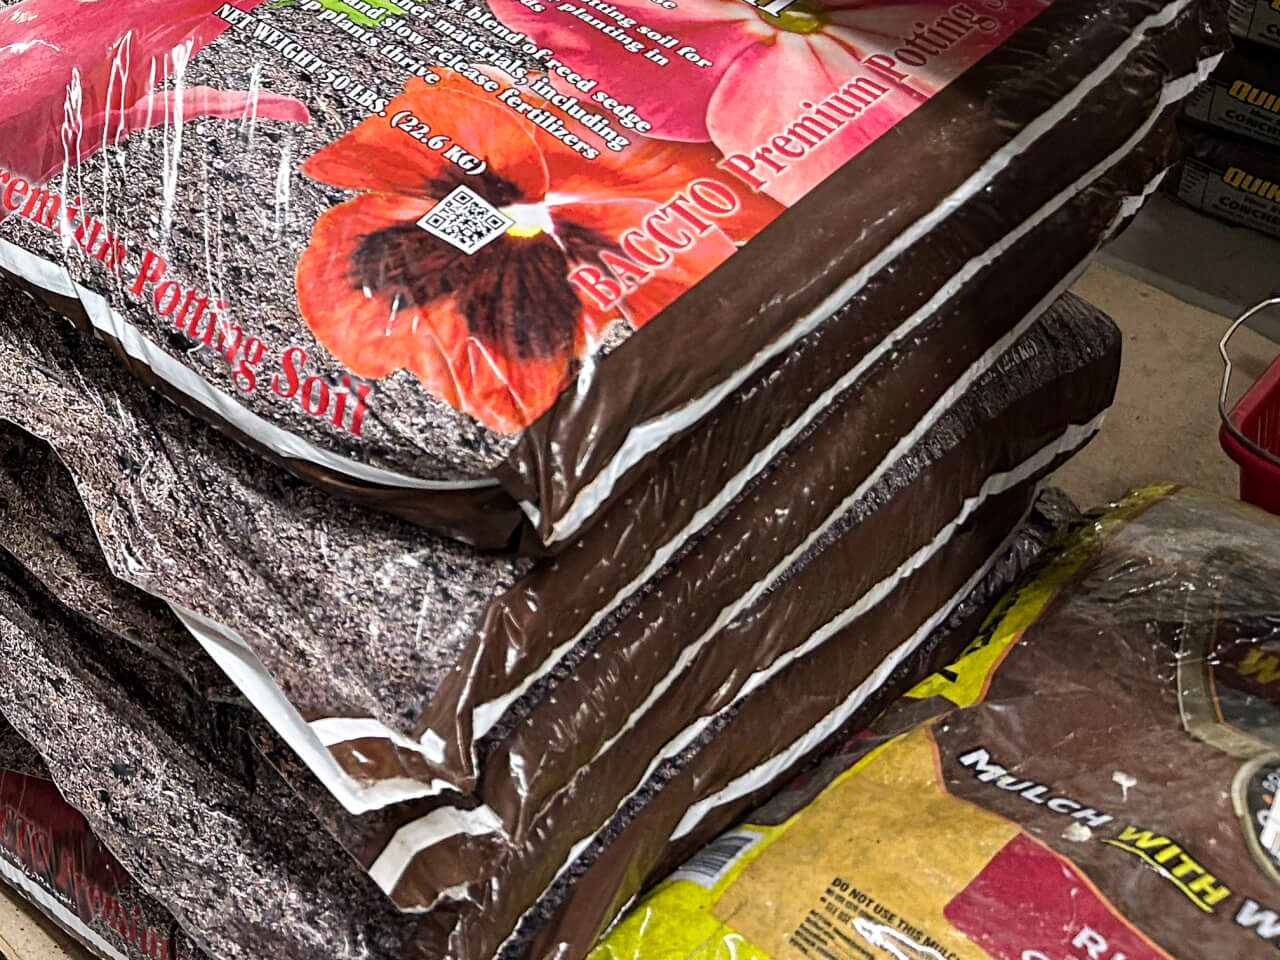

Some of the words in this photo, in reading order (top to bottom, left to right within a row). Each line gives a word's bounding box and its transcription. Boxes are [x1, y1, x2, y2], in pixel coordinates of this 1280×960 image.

[213, 3, 257, 31] NET
[253, 21, 327, 76] WEIGHT
[321, 69, 349, 92] 50
[344, 82, 392, 119] LBS.
[389, 110, 451, 152] (22.6
[441, 137, 489, 178] KG)
[318, 5, 379, 48] plants
[379, 43, 442, 86] thrive
[381, 16, 501, 93] slow-release
[497, 85, 602, 162] fertilizers
[433, 17, 532, 91] materials,
[530, 76, 633, 154] including
[466, 5, 527, 47] blend
[521, 37, 554, 63] of
[546, 56, 598, 94] reed
[591, 89, 653, 135] sedge
[557, 3, 646, 57] planting
[644, 46, 670, 67] in
[636, 23, 680, 50] soil
[675, 44, 714, 70] for
[566, 176, 744, 312] BACCTO
[722, 69, 891, 193] Premium
[130, 247, 269, 394] Potting
[268, 345, 374, 440] Soil
[57, 855, 190, 960] Premiu
[957, 747, 1115, 828] MULCH
[1117, 825, 1233, 908] WITH
[1234, 897, 1280, 940] W
[830, 876, 850, 893] DO
[847, 887, 876, 909] NOT
[871, 902, 898, 924] USE
[895, 918, 925, 942] THIS
[921, 935, 962, 960] MULC
